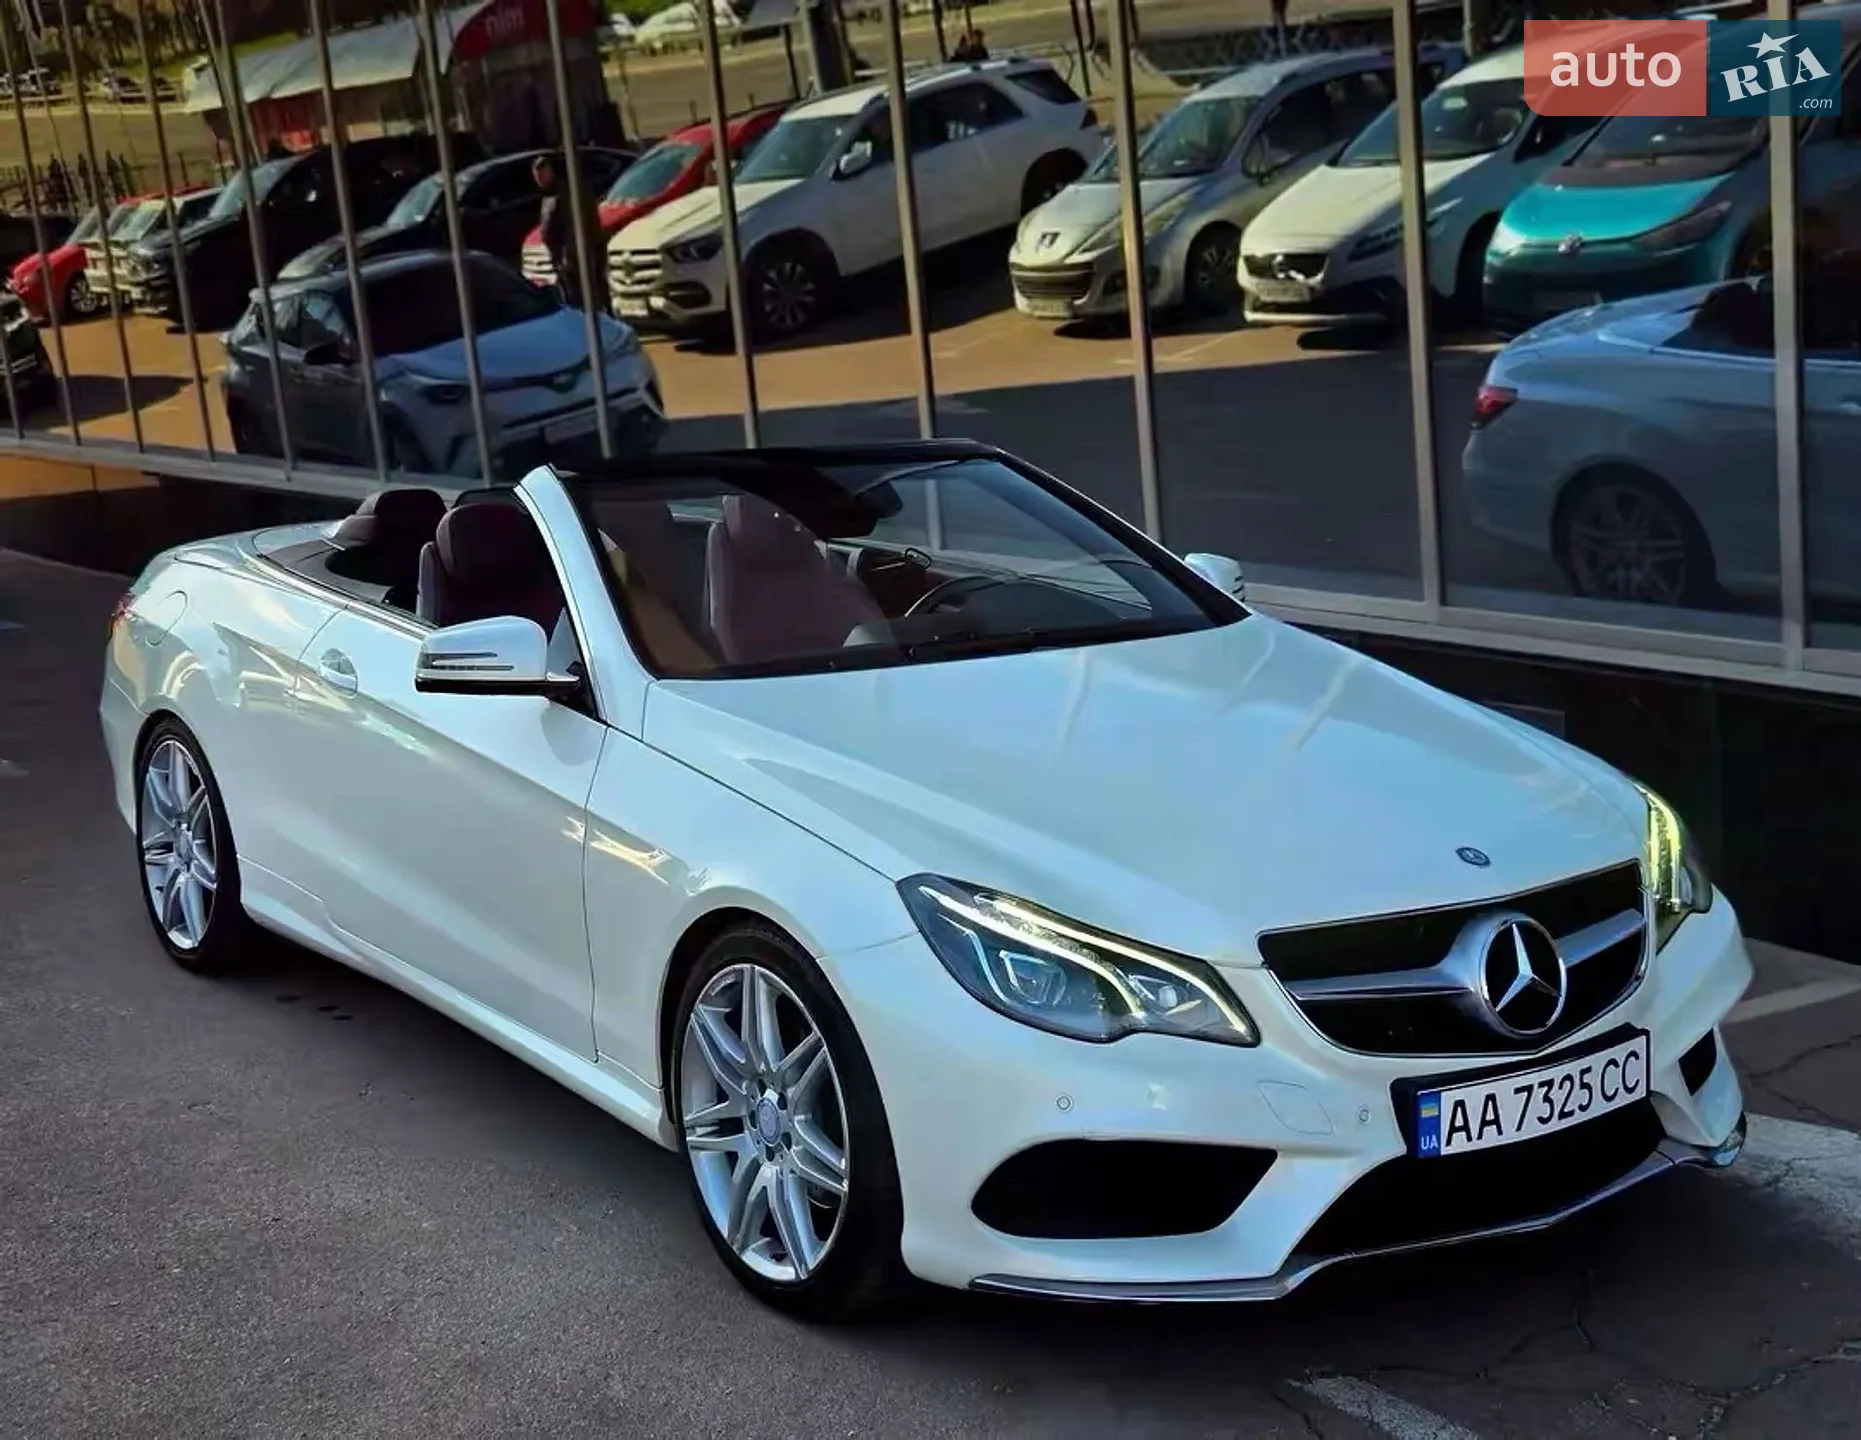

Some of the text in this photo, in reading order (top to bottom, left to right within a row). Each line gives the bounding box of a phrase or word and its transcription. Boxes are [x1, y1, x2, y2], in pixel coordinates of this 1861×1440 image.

[1445, 1049, 1640, 1147] AA 7325 CC
[1421, 1137, 1439, 1151] UA
